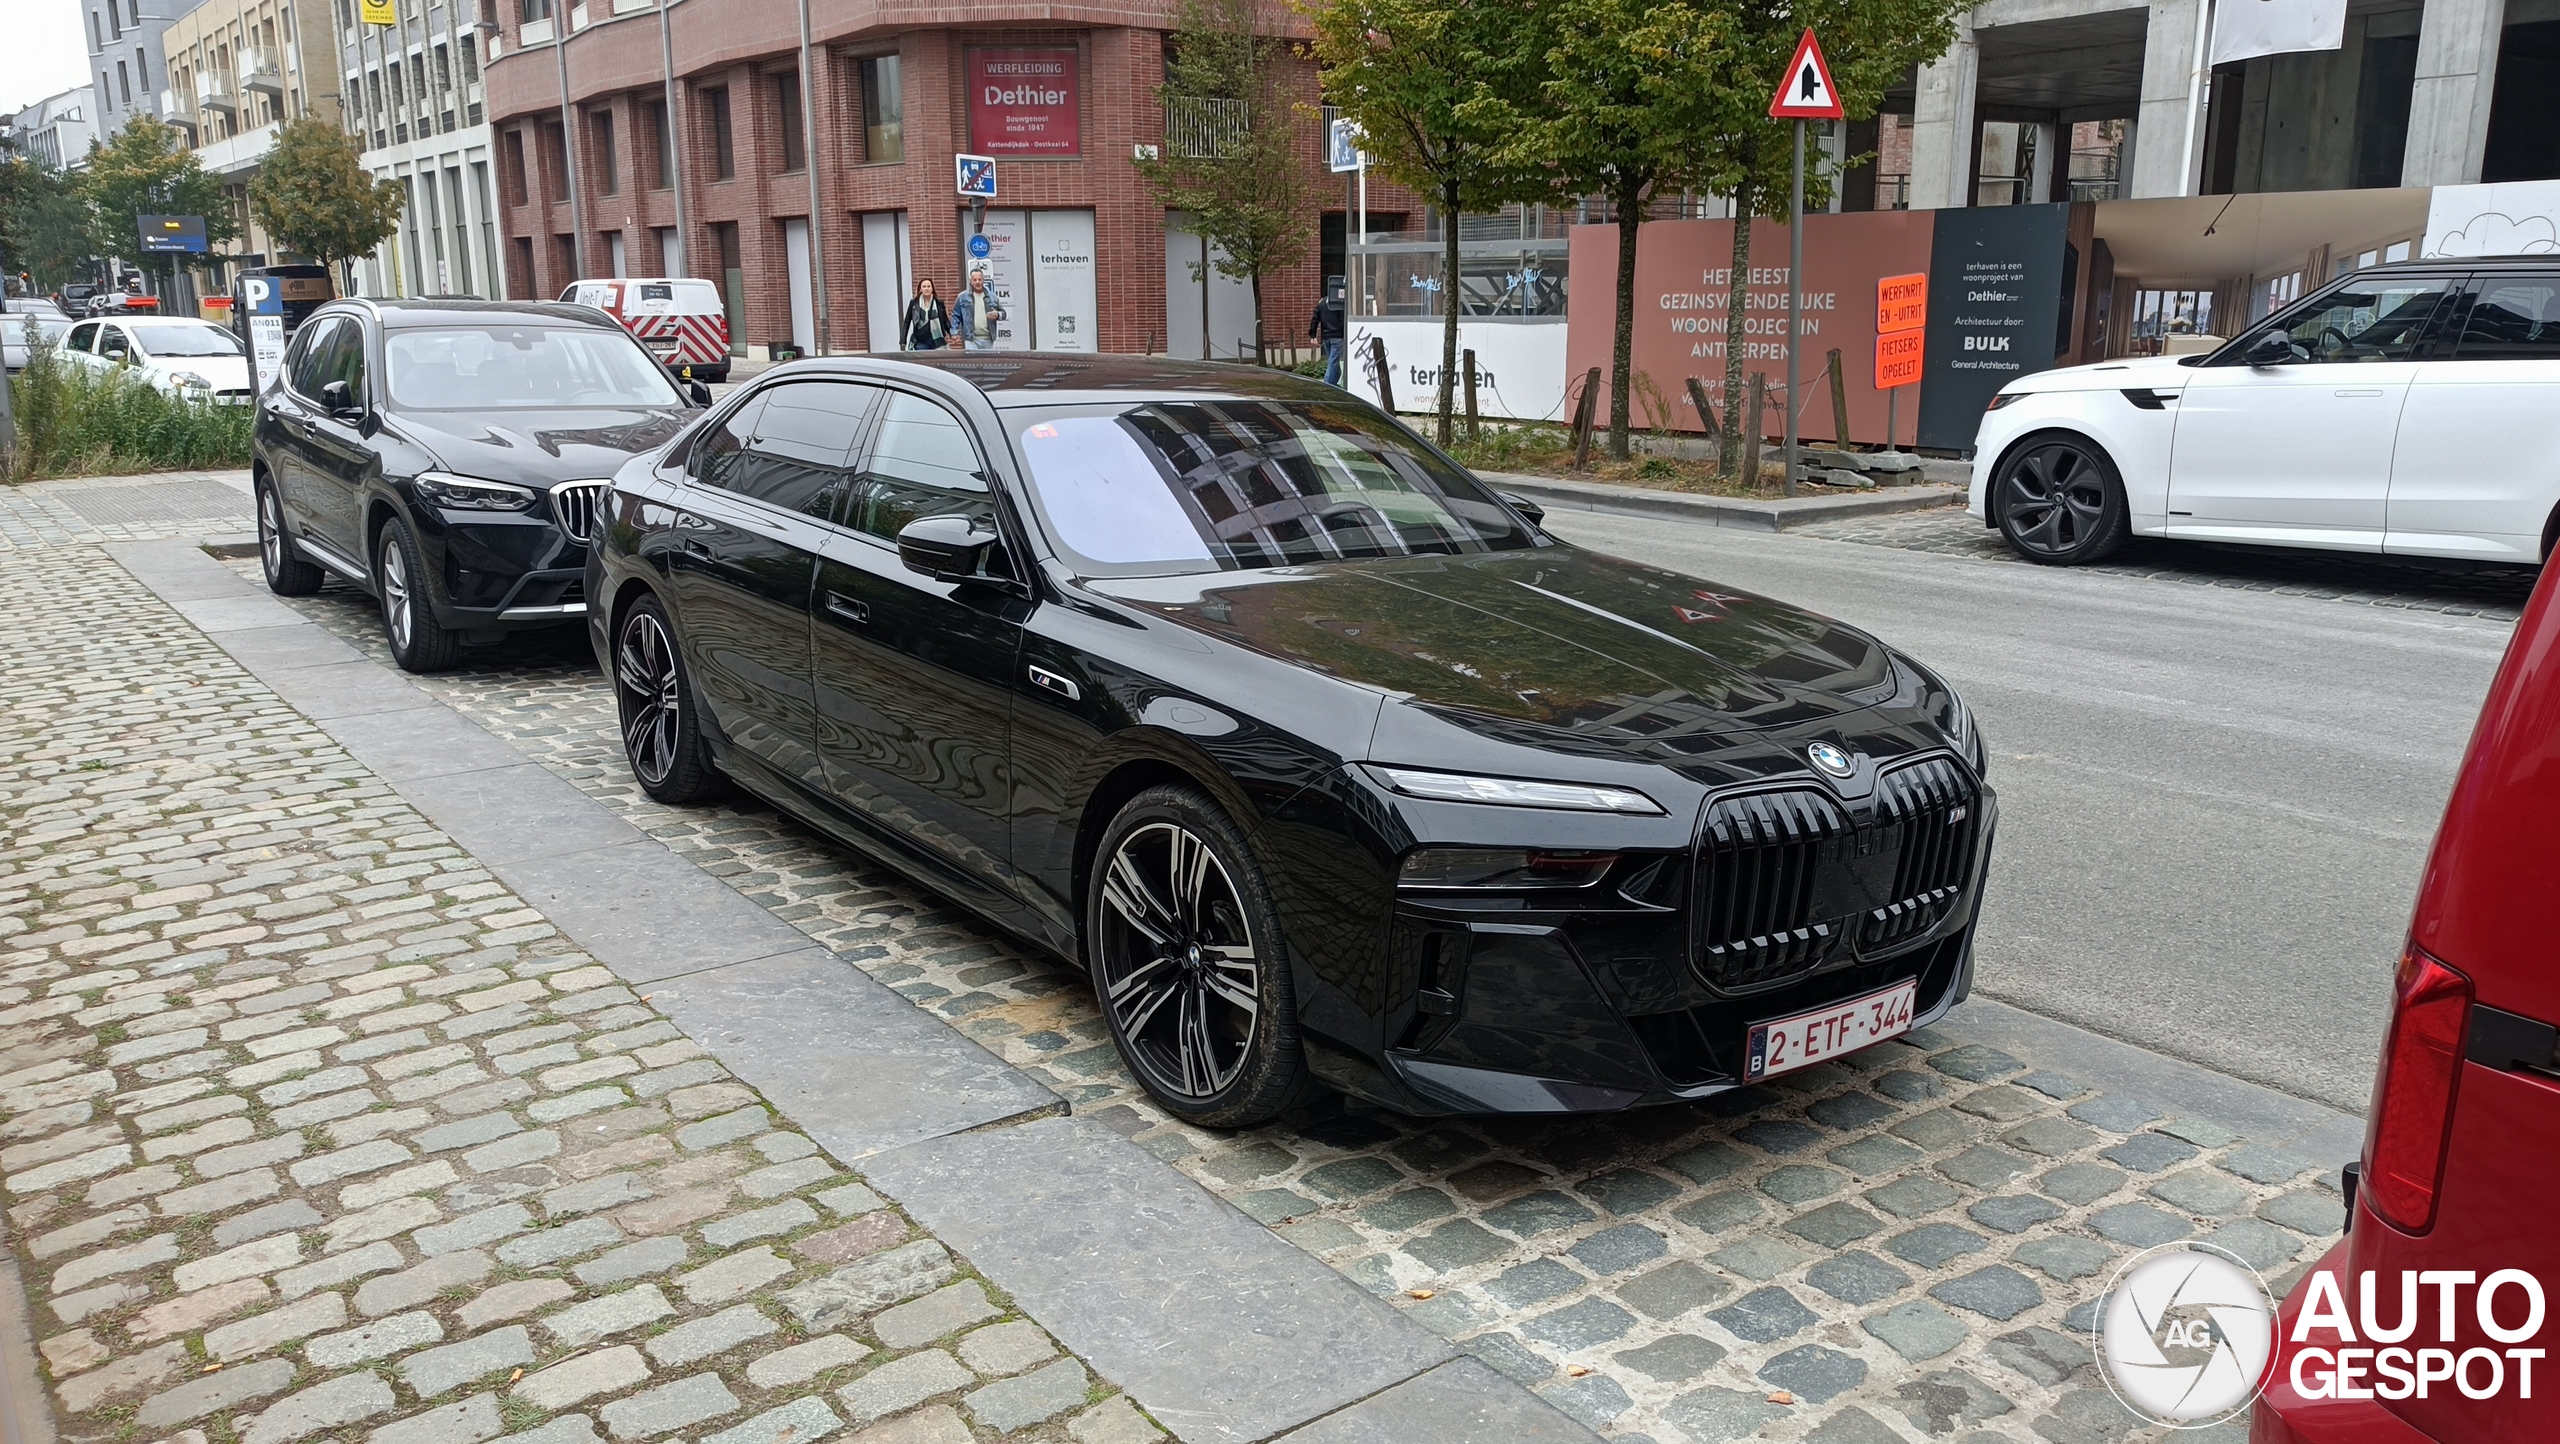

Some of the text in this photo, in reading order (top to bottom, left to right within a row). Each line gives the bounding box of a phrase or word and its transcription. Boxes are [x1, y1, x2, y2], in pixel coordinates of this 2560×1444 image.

[987, 63, 1062, 73] WERFLEIDING
[985, 85, 1067, 105] Dethier
[1006, 115, 1049, 124] Bouwgenoot
[1028, 123, 1045, 131] 1947
[987, 141, 1029, 149] Kattendijkdok
[1041, 254, 1089, 263] terhaven
[1966, 261, 2022, 271] terhaven is een
[1703, 268, 1733, 285] HET
[1963, 273, 2024, 284] woonproject van
[244, 279, 270, 310] P
[1881, 282, 1923, 302] WERFINRIT
[1968, 290, 2007, 302] Dethier
[1660, 292, 1836, 310] GEZINSVENDEIJKE
[252, 318, 281, 327] AN011
[1880, 308, 1890, 324] EN
[1955, 316, 2024, 326] Architectuur door:
[1800, 318, 1819, 335] IN
[1881, 336, 1919, 356] FIETSERS
[1964, 336, 2010, 351] BULK
[1883, 360, 1916, 380] OPGELET
[1951, 360, 2020, 370] General Architecture
[1768, 991, 1912, 1067] 2-ETF-344
[1751, 1055, 1762, 1072] B
